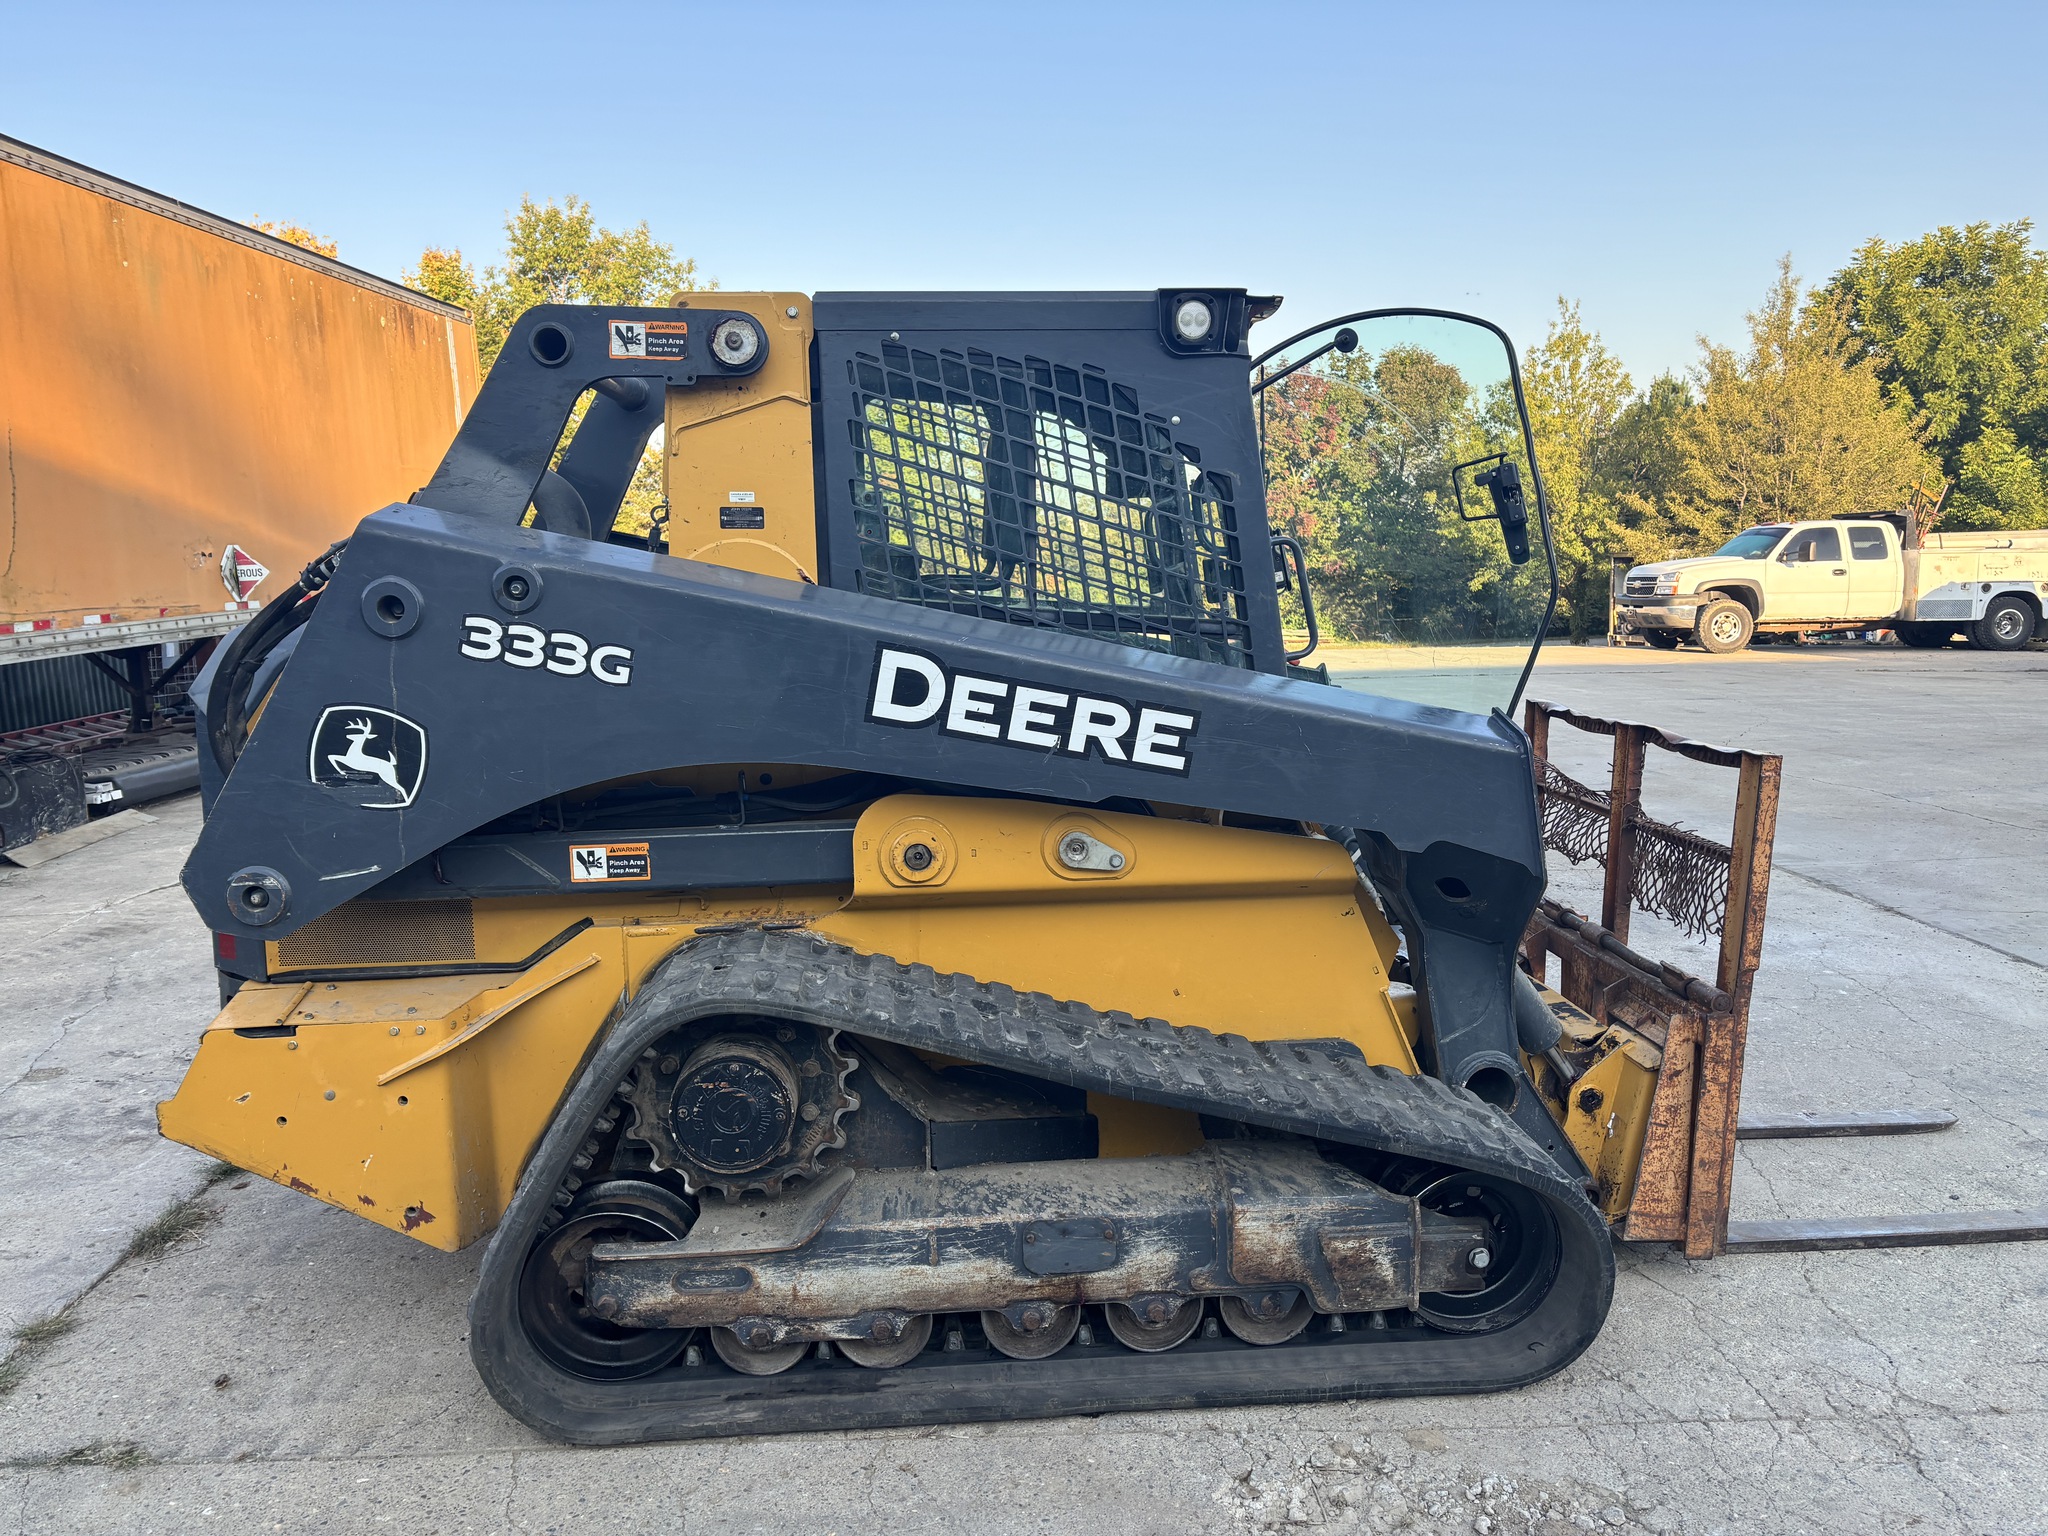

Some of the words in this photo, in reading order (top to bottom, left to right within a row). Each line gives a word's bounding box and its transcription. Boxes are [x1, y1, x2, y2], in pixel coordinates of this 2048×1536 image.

[654, 323, 685, 331] WARNING
[237, 568, 263, 578] EROUS
[461, 616, 632, 684] 333G
[872, 648, 1194, 770] DEERE
